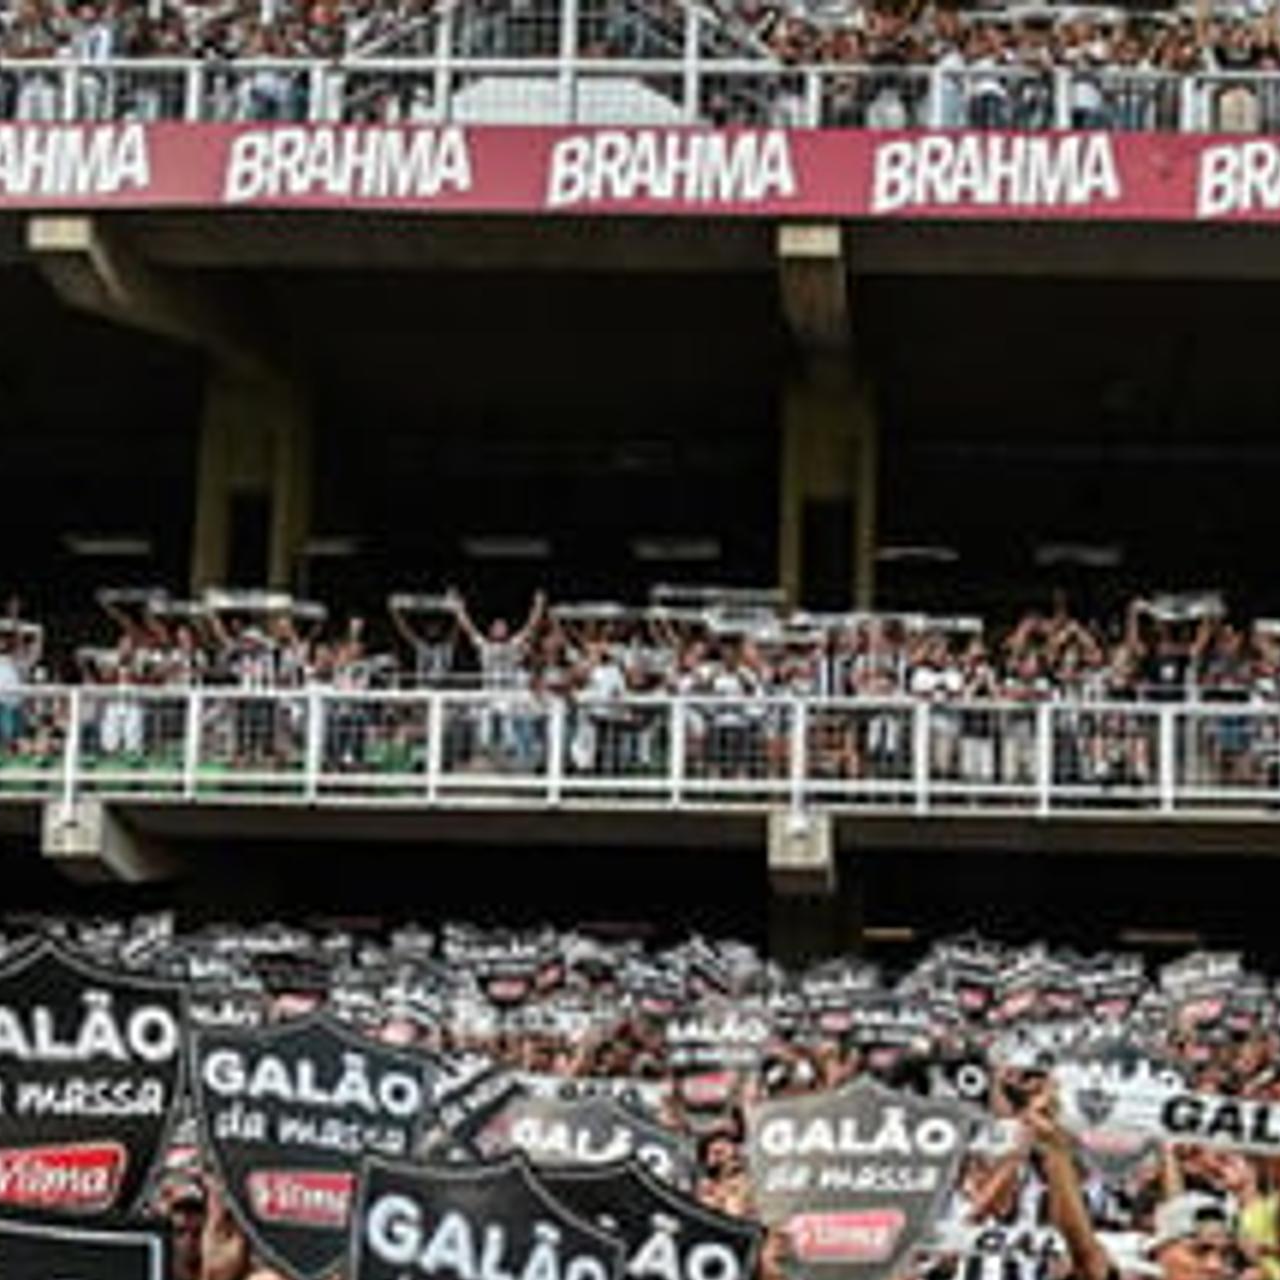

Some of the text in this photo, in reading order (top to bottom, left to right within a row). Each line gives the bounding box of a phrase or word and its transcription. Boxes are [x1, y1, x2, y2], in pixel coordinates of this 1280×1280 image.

[224, 126, 473, 203] BRAHMA
[545, 131, 795, 209] BRAHMA
[871, 135, 1120, 214] BRAHMA
[20, 1077, 162, 1117] massa
[203, 1050, 420, 1115] GALÃO
[214, 1099, 407, 1152] da massa
[759, 1105, 957, 1155] GALÃO
